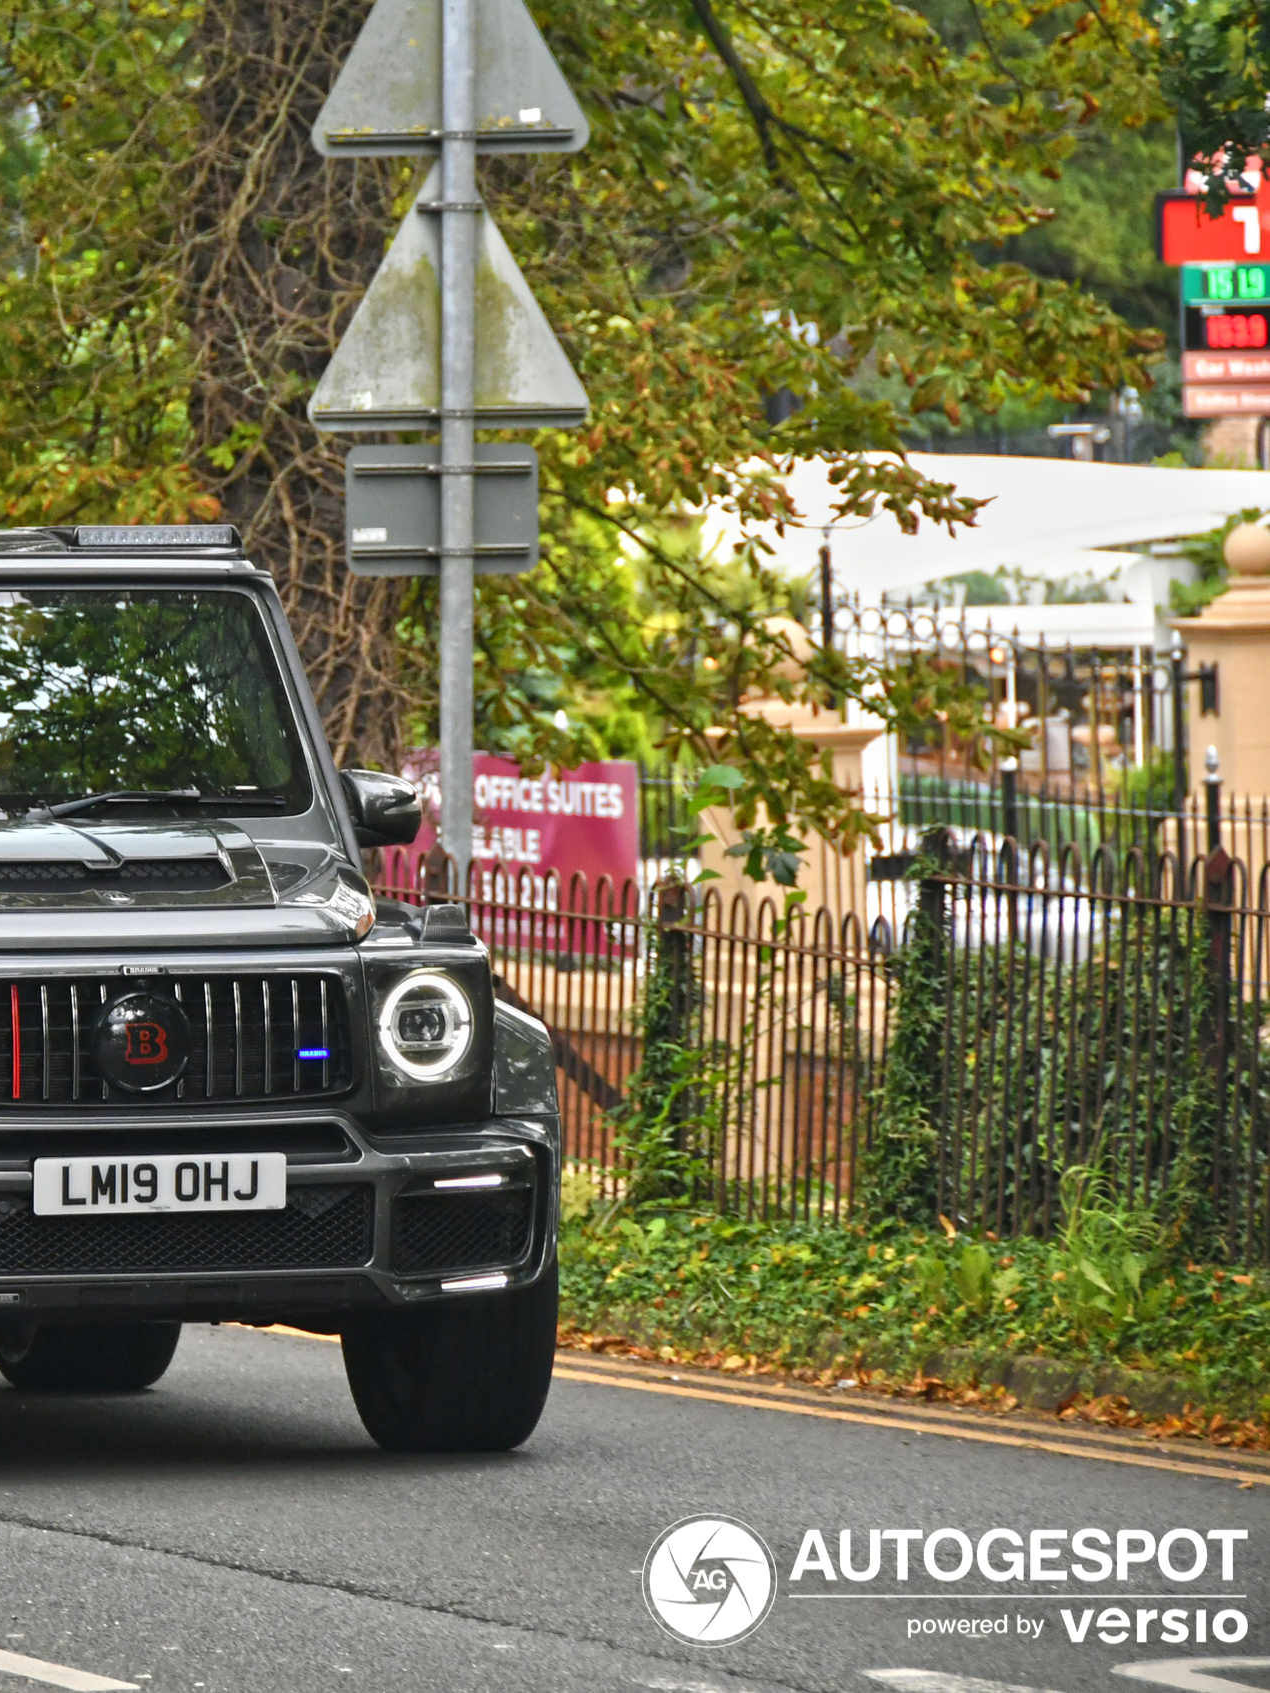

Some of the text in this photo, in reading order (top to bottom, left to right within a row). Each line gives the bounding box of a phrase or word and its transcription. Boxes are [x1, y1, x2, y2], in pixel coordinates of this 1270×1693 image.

[474, 774, 544, 812] OFFICE
[547, 781, 624, 819] SUITES
[125, 1022, 168, 1065] B
[62, 1160, 258, 1206] LM19 OHJ
